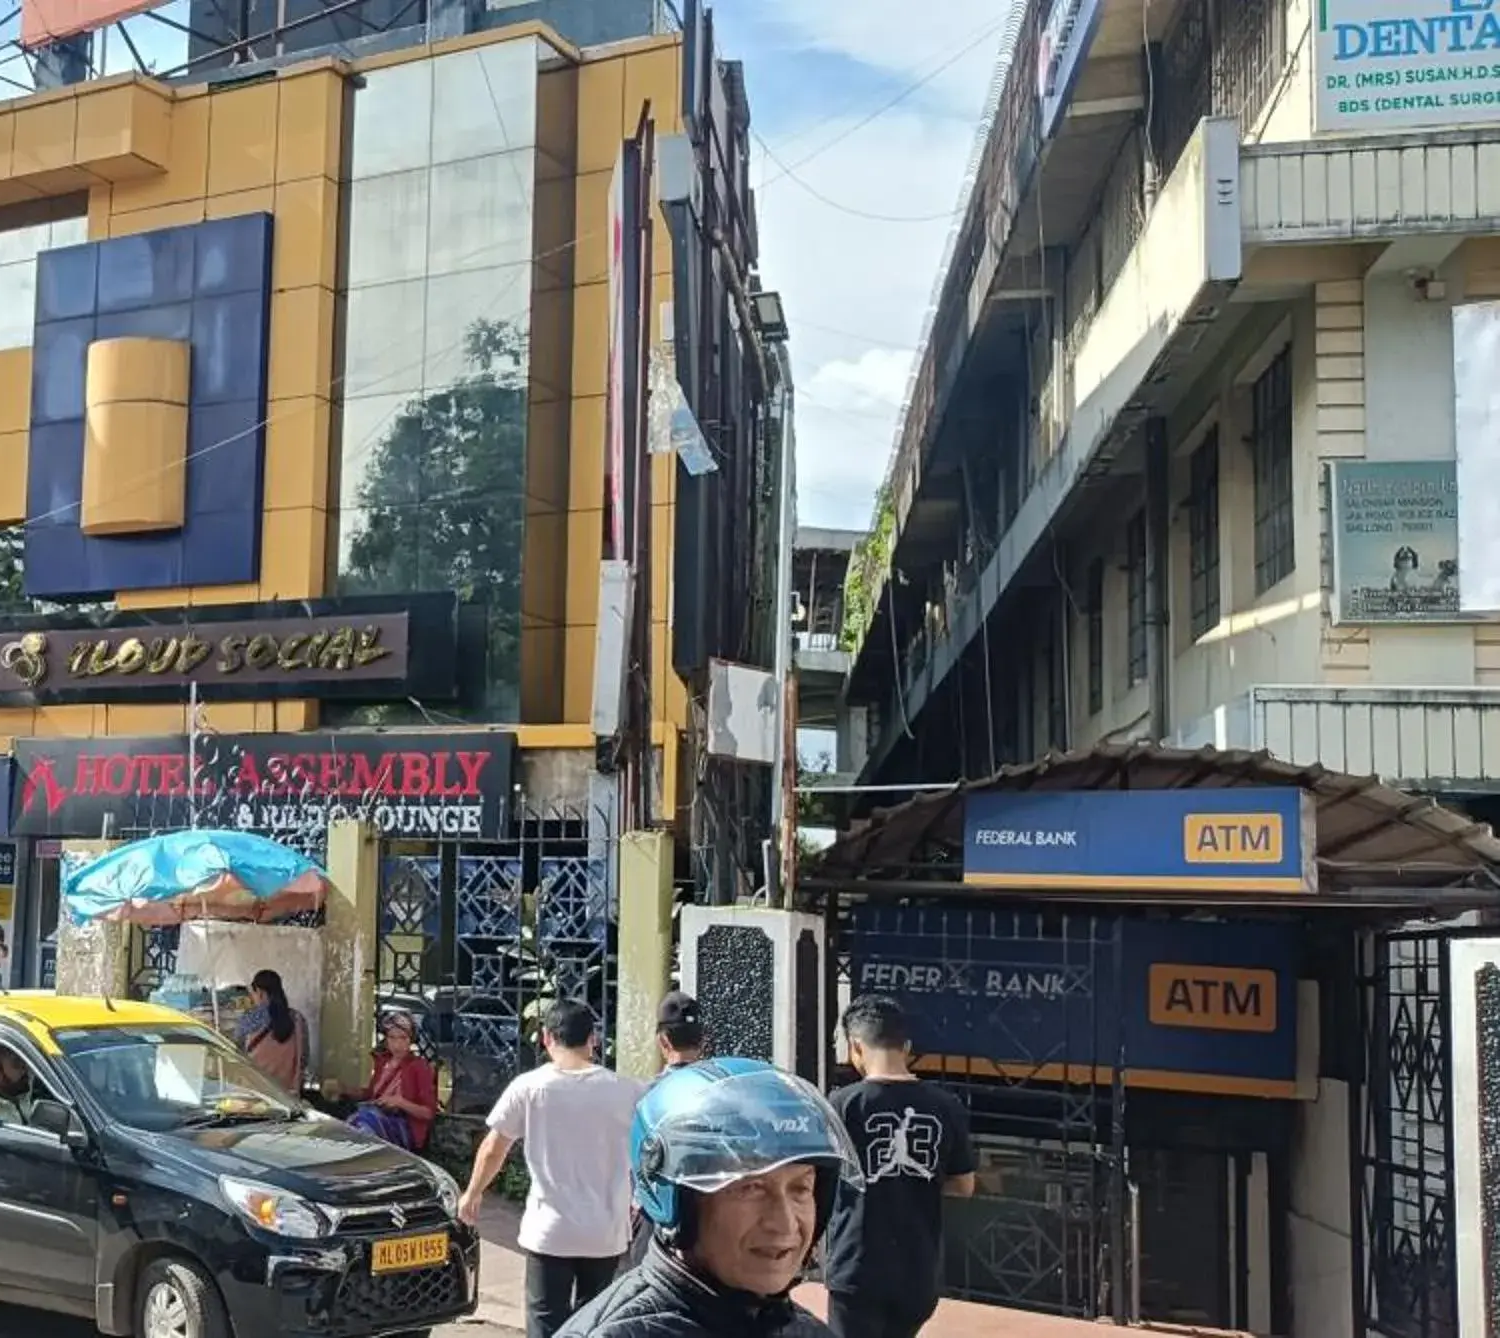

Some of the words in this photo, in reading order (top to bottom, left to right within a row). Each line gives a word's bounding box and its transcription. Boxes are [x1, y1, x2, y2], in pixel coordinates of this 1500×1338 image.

[1327, 75, 1350, 89] DR.
[1356, 70, 1400, 88] (MRS)
[1338, 100, 1370, 113] BDS
[1375, 95, 1444, 112] (DENTAL
[217, 625, 392, 675] SOCIAL
[232, 751, 490, 797] ASSEMBLY
[354, 805, 481, 833] OUNGE
[976, 830, 1032, 846] FEDERAL
[1036, 831, 1077, 847] BANK
[1197, 824, 1271, 853] ATM
[1164, 978, 1261, 1017] ATM
[865, 1112, 943, 1180] 23
